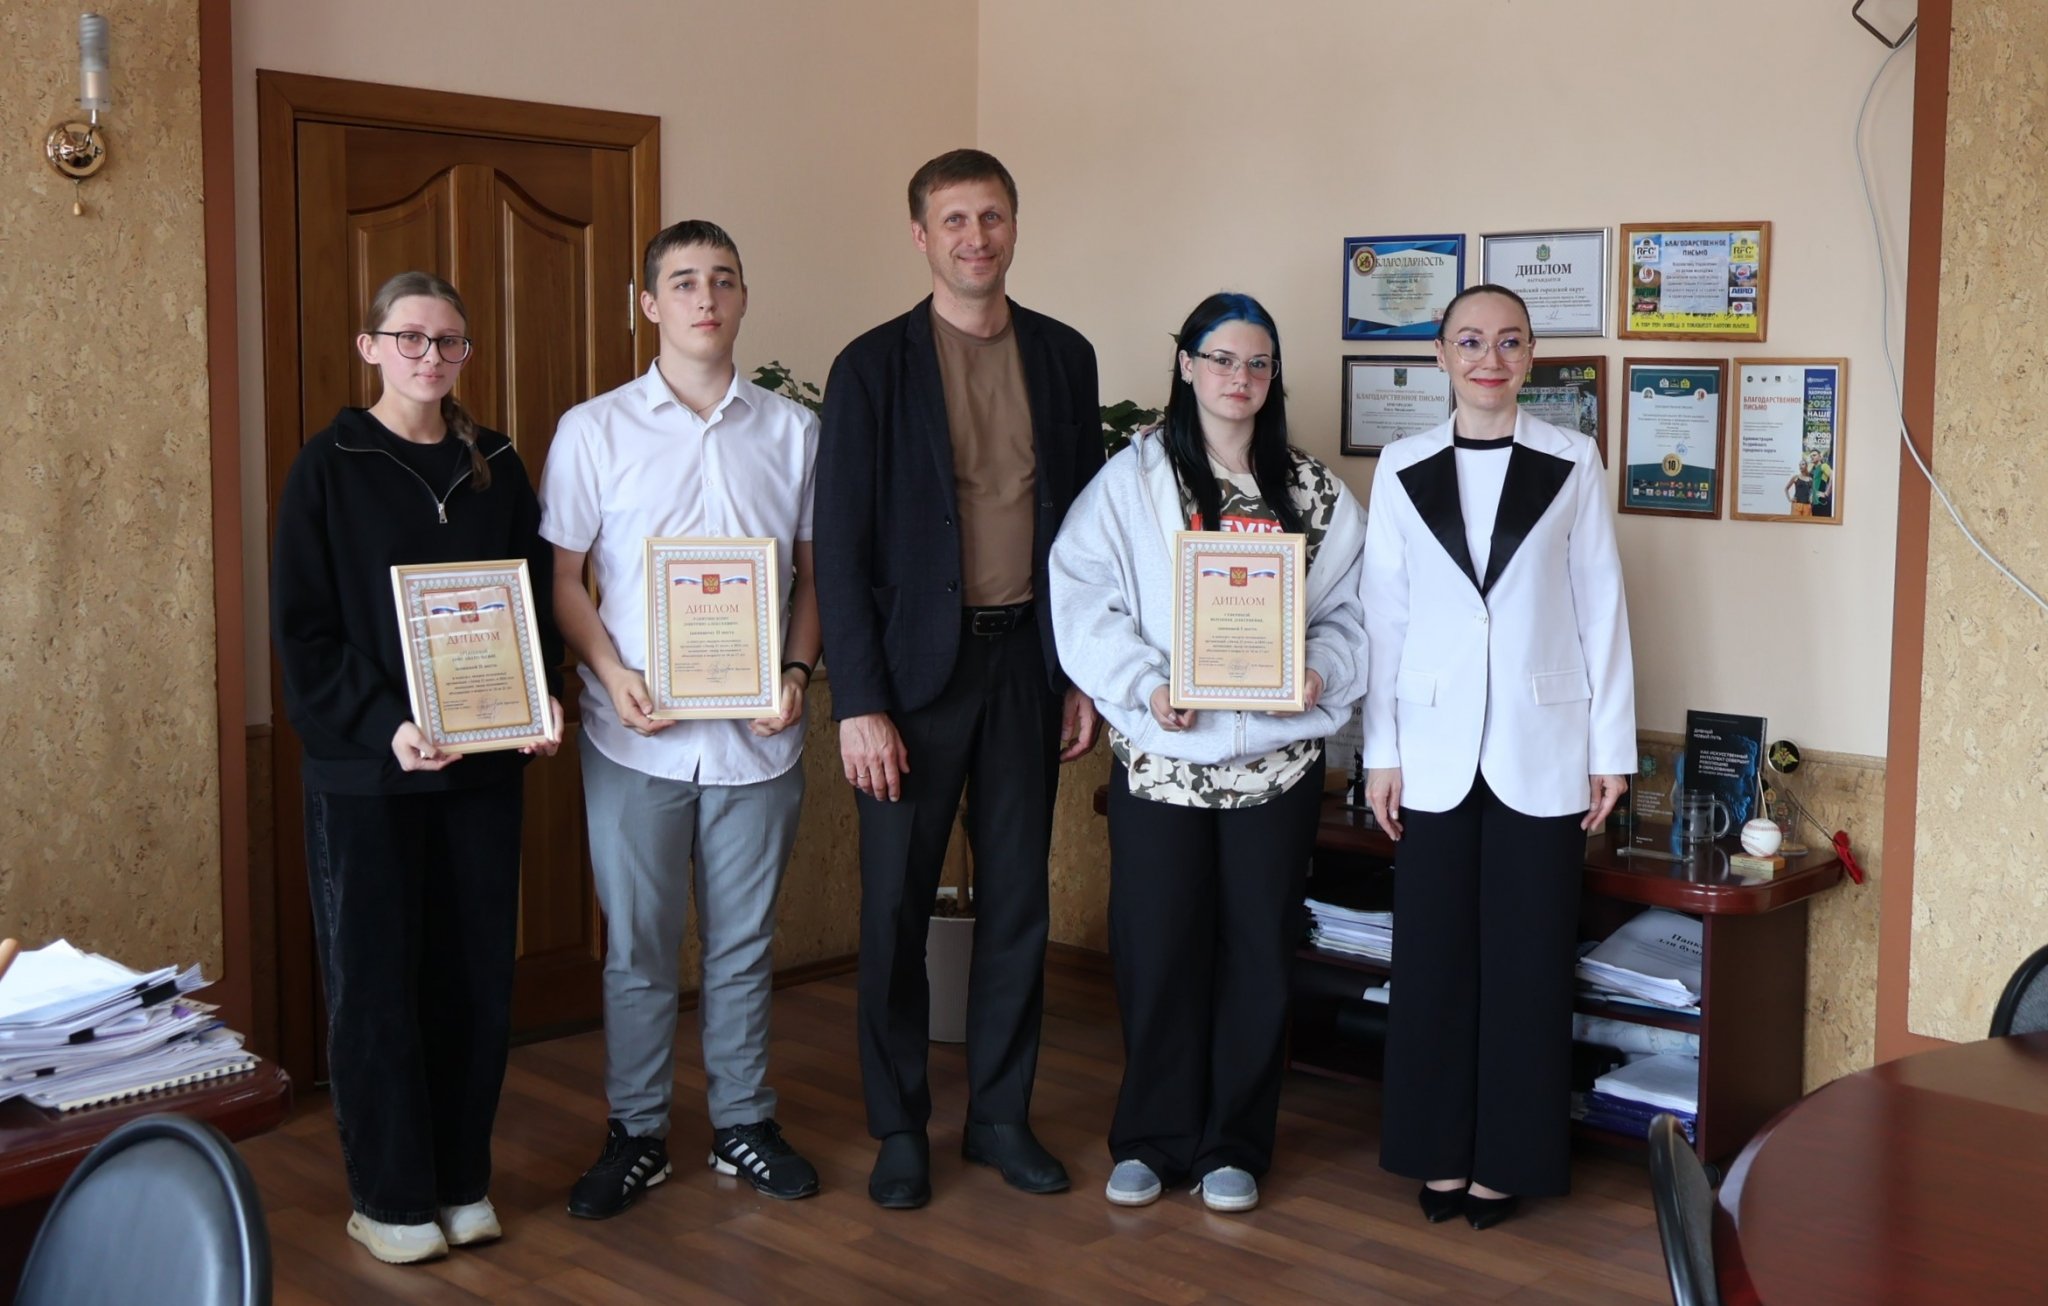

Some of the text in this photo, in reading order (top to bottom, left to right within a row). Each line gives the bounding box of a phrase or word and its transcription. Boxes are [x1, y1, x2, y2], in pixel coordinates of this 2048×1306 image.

[1664, 239, 1727, 247] БЛАГОДАРСТВЕННОЕ
[1515, 263, 1572, 278] ДИПЛОМ
[1418, 394, 1445, 402] ПИСЬМО
[1743, 396, 1802, 404] БЛАГОДАРСТВЕННОЕ
[1743, 403, 1768, 411] ПИСЬМО
[1808, 400, 1832, 408] 2022
[1668, 460, 1676, 471] 10
[1211, 596, 1265, 606] ДИПЛОМ
[685, 604, 739, 615] ДИПЛОМ
[446, 631, 500, 645] ДИПЛОМ
[1671, 933, 1702, 948] Папк
